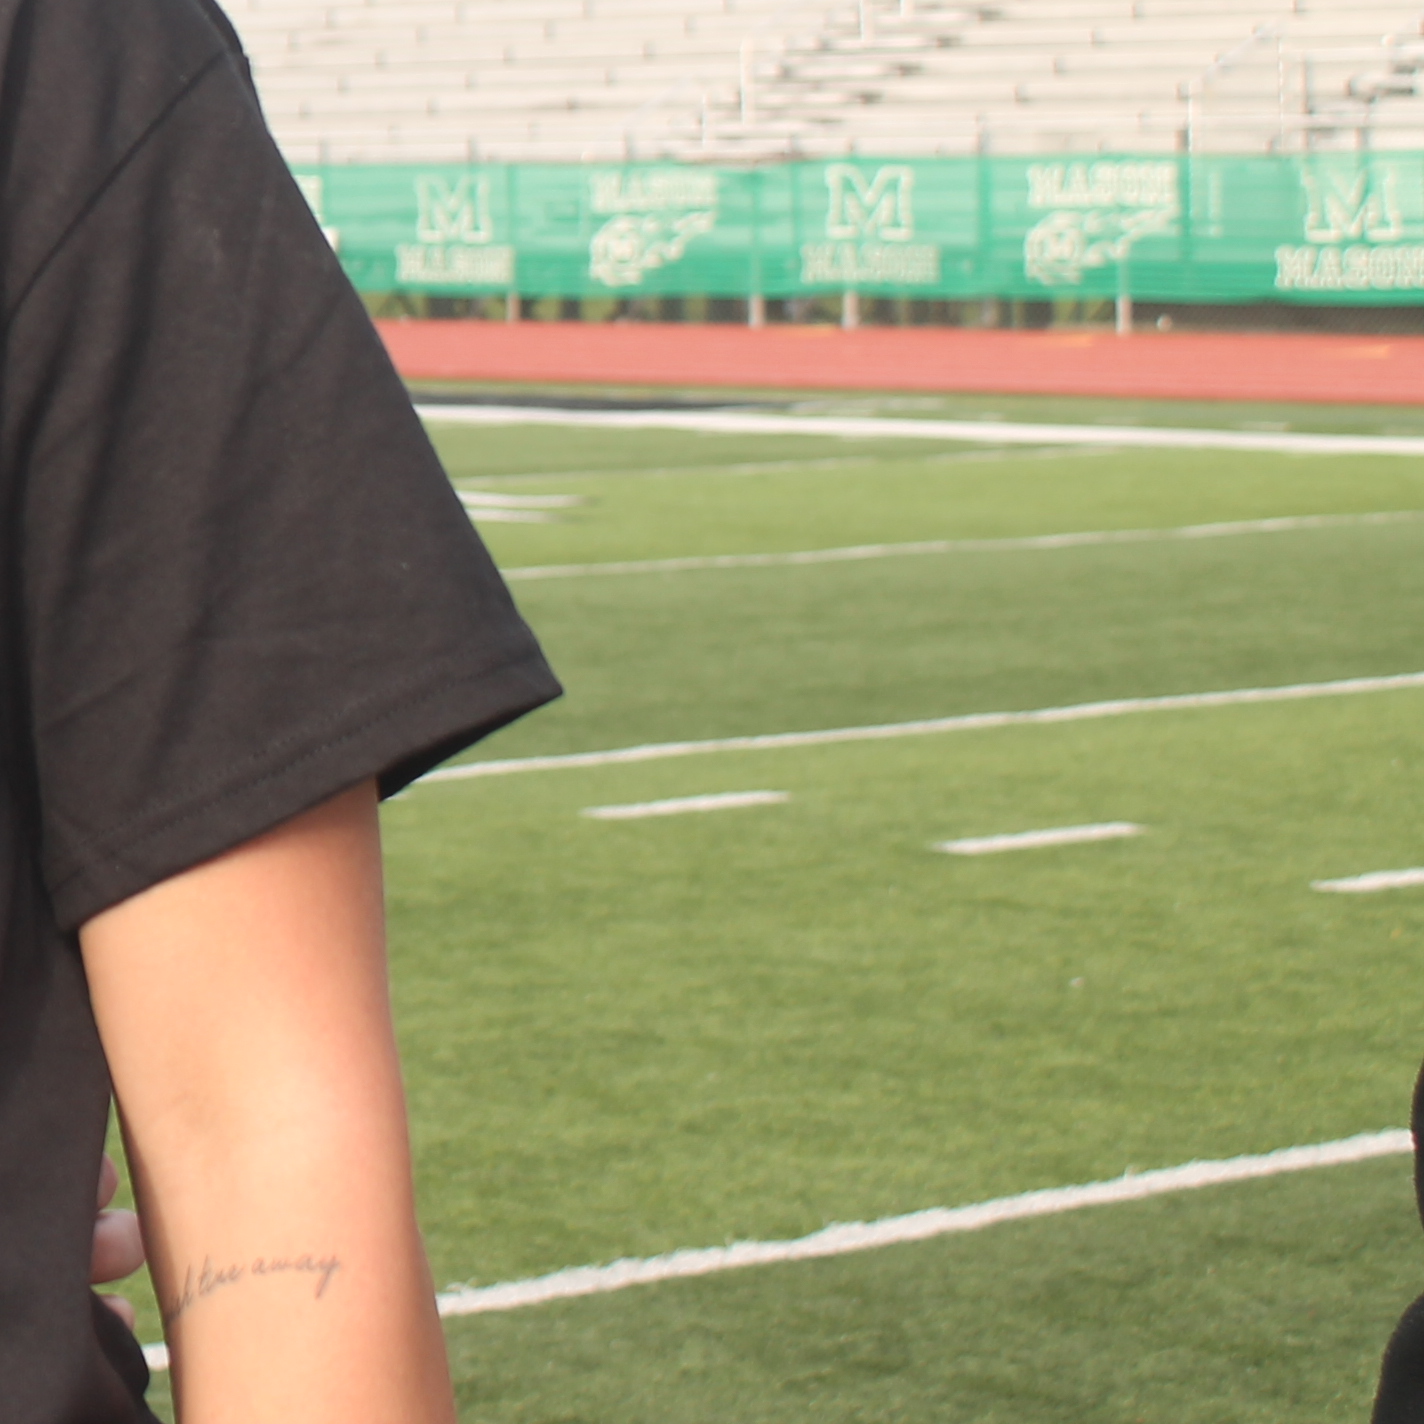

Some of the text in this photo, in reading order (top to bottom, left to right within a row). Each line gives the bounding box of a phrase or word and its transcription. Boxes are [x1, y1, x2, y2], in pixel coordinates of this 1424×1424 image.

[413, 173, 494, 243] M
[824, 162, 915, 241] M
[1300, 159, 1402, 243] M
